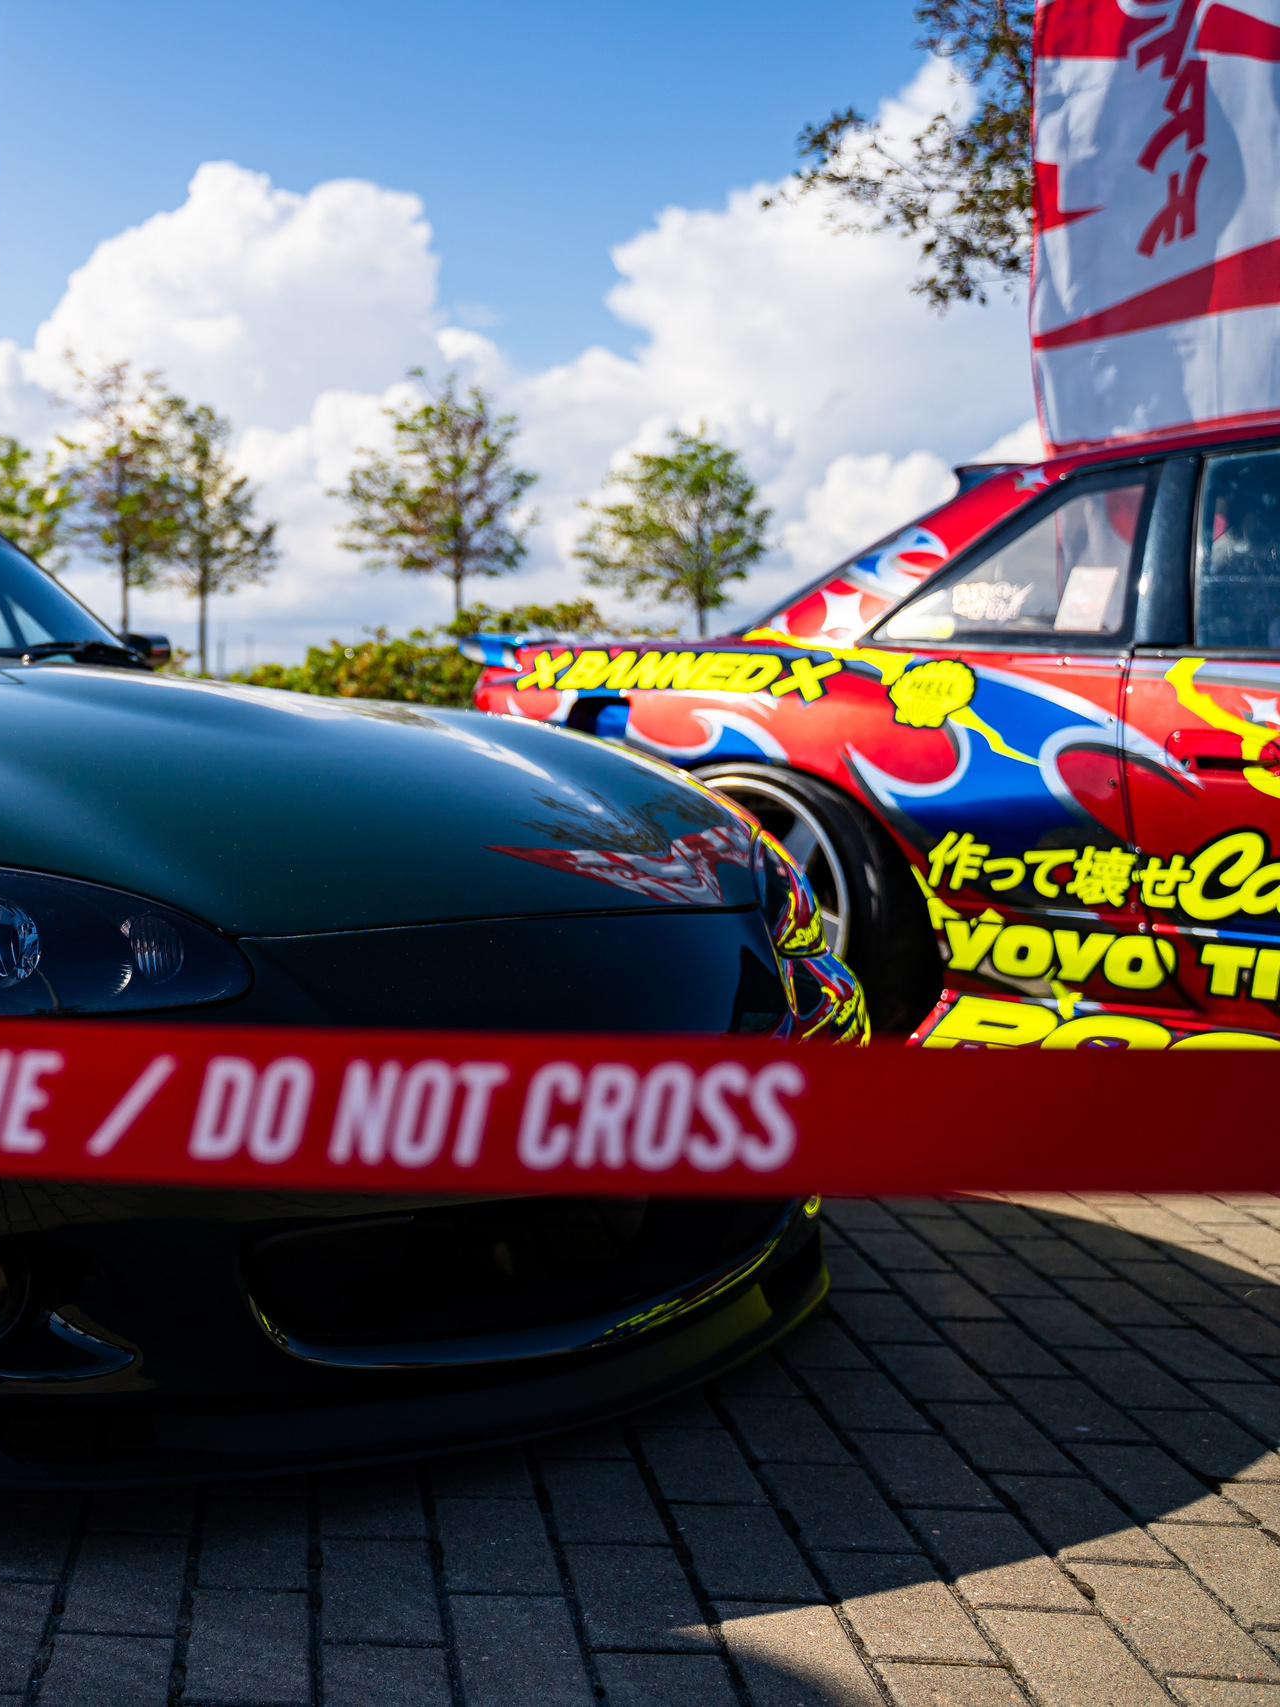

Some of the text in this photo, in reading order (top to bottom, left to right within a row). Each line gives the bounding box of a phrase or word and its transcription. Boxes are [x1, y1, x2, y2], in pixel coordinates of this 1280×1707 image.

[556, 650, 782, 690] BANNED
[927, 831, 1193, 909] 作って壊せ
[944, 918, 1176, 990] YOYO
[86, 1054, 177, 1158] /
[188, 1055, 314, 1165] DO
[328, 1058, 511, 1168] NOT
[516, 1060, 806, 1172] CROSS
